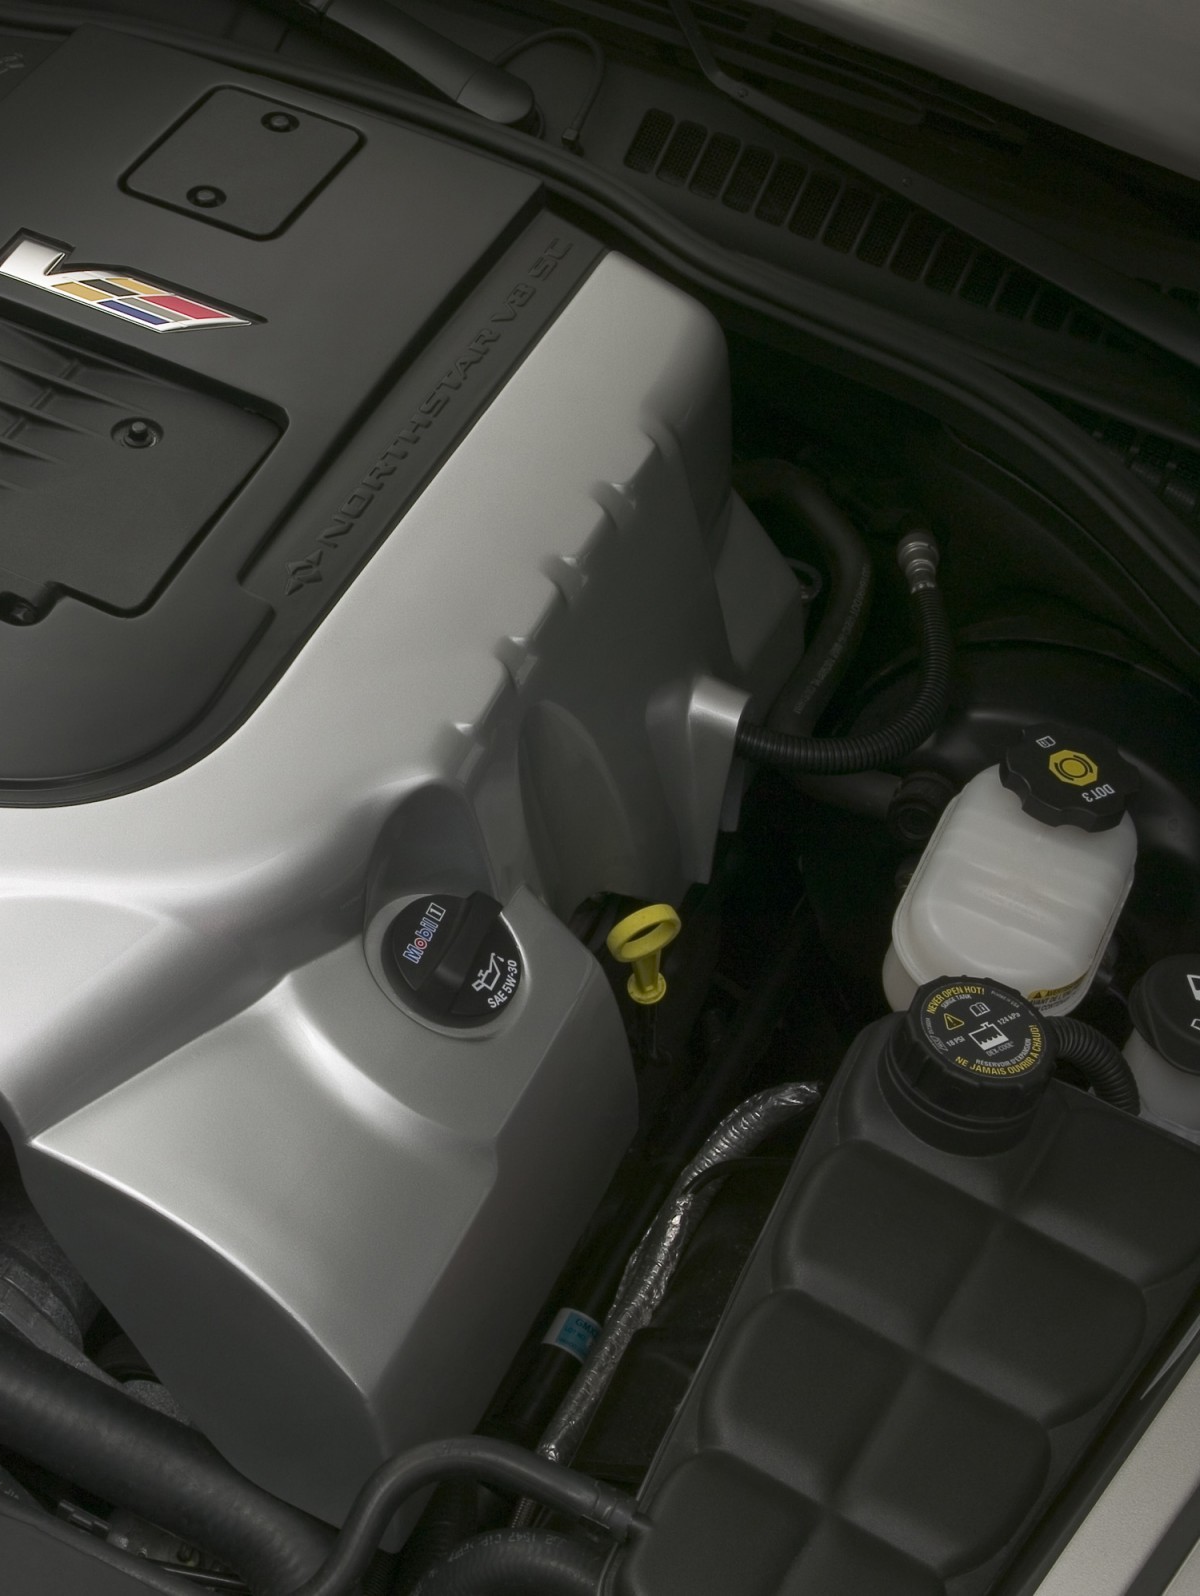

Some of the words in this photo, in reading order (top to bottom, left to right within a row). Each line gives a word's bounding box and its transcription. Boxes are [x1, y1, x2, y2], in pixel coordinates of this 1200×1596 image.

[319, 328, 500, 548] NORTHSTAR
[492, 282, 536, 324] V8
[530, 238, 574, 281] SC
[403, 917, 438, 964] Mobil
[487, 991, 508, 1008] SAE
[503, 960, 517, 993] 5W-30
[926, 994, 944, 1014] NEVER
[942, 986, 964, 998] OPEN
[964, 986, 984, 995] HOT!
[954, 1036, 966, 1044] PSI
[997, 1016, 1009, 1026] 124
[1008, 1012, 1021, 1020] kPa
[955, 1056, 969, 1067] NE
[969, 1064, 1007, 1075] JAMAIS
[1007, 1056, 1035, 1074] OUVRIR
[1028, 1024, 1042, 1052] CHAUD!
